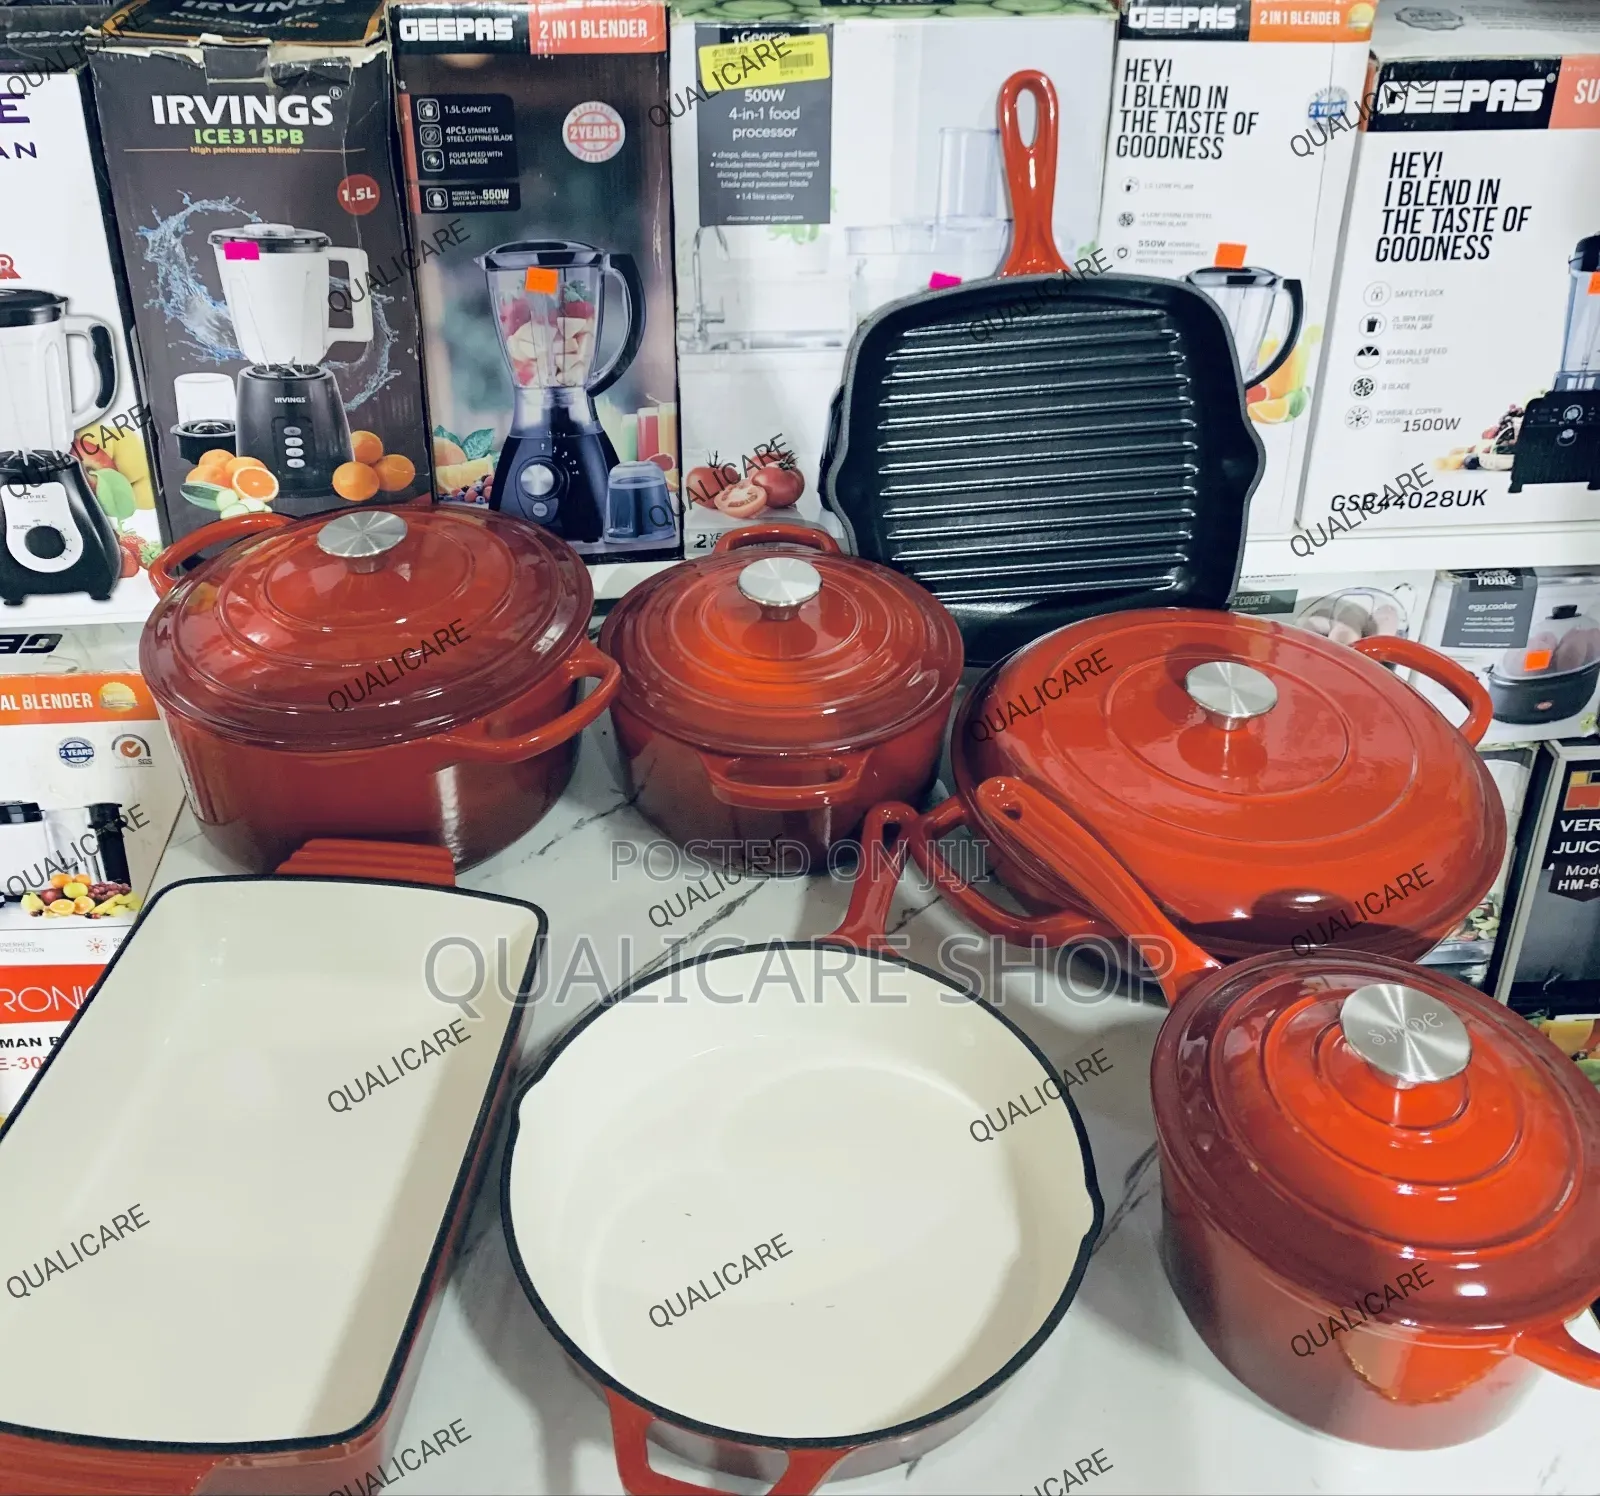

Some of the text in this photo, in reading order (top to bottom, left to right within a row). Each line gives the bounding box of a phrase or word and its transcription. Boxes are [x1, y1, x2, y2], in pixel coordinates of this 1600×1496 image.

[1127, 6, 1236, 30] GEEPAS
[1260, 11, 1340, 26] 2 IN 1 BLENDER
[398, 18, 514, 42] GEEPAS
[539, 20, 648, 39] 2 IN 1 BLENDER
[1124, 58, 1172, 83] HEY!
[744, 88, 786, 103] 500W
[1121, 84, 1229, 109] I BLEND IN
[1377, 78, 1546, 115] GEEPAS
[444, 105, 492, 114] 1.5L CAPACITY
[729, 105, 800, 120] 4-in-1 food
[1120, 109, 1259, 136] THE TASTE OF
[194, 129, 304, 145] ICE315PB
[446, 126, 466, 135] 4PCS
[493, 134, 513, 142] BLADE
[732, 127, 798, 142] processor
[190, 146, 300, 155] High performance Blender
[487, 150, 503, 158] WITH
[1116, 135, 1224, 160] GOODNESS
[1389, 151, 1443, 178] HEY!
[342, 187, 376, 202] 1.5L
[1384, 178, 1501, 207] I BLEND IN
[1382, 205, 1532, 235] THE TASTE OF
[1138, 240, 1166, 248] 550W
[1376, 234, 1493, 262] GOODNESS
[274, 396, 306, 404] IRVINGS
[1402, 417, 1461, 433] 1500W
[1331, 489, 1488, 512] GSB44028UK
[693, 534, 706, 548] 2
[21, 692, 93, 710] BLENDER
[67, 748, 93, 756] YEARS
[1565, 864, 1600, 876] Mod
[1557, 878, 1600, 891] HM-6
